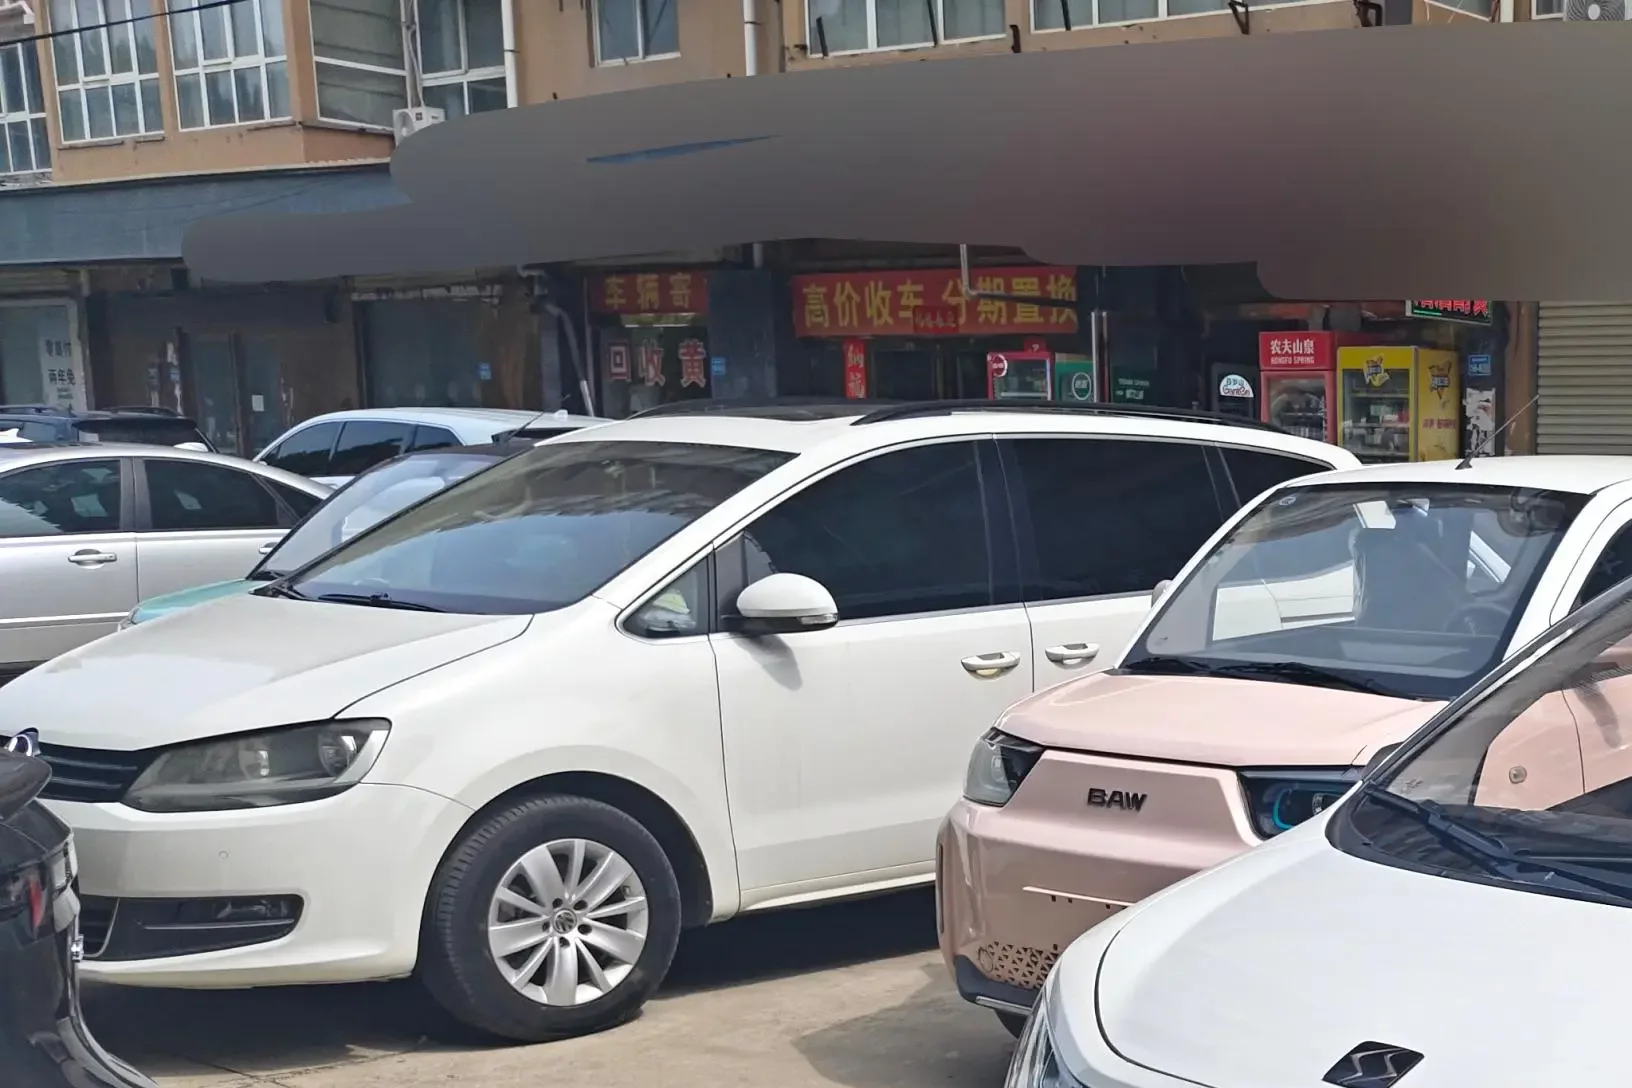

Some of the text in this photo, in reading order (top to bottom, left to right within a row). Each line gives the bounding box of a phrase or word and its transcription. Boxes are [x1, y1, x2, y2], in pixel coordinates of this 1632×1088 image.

[802, 277, 925, 328] 高价收车
[1270, 338, 1315, 355] 农夫山泉
[1087, 787, 1148, 812] BAW
